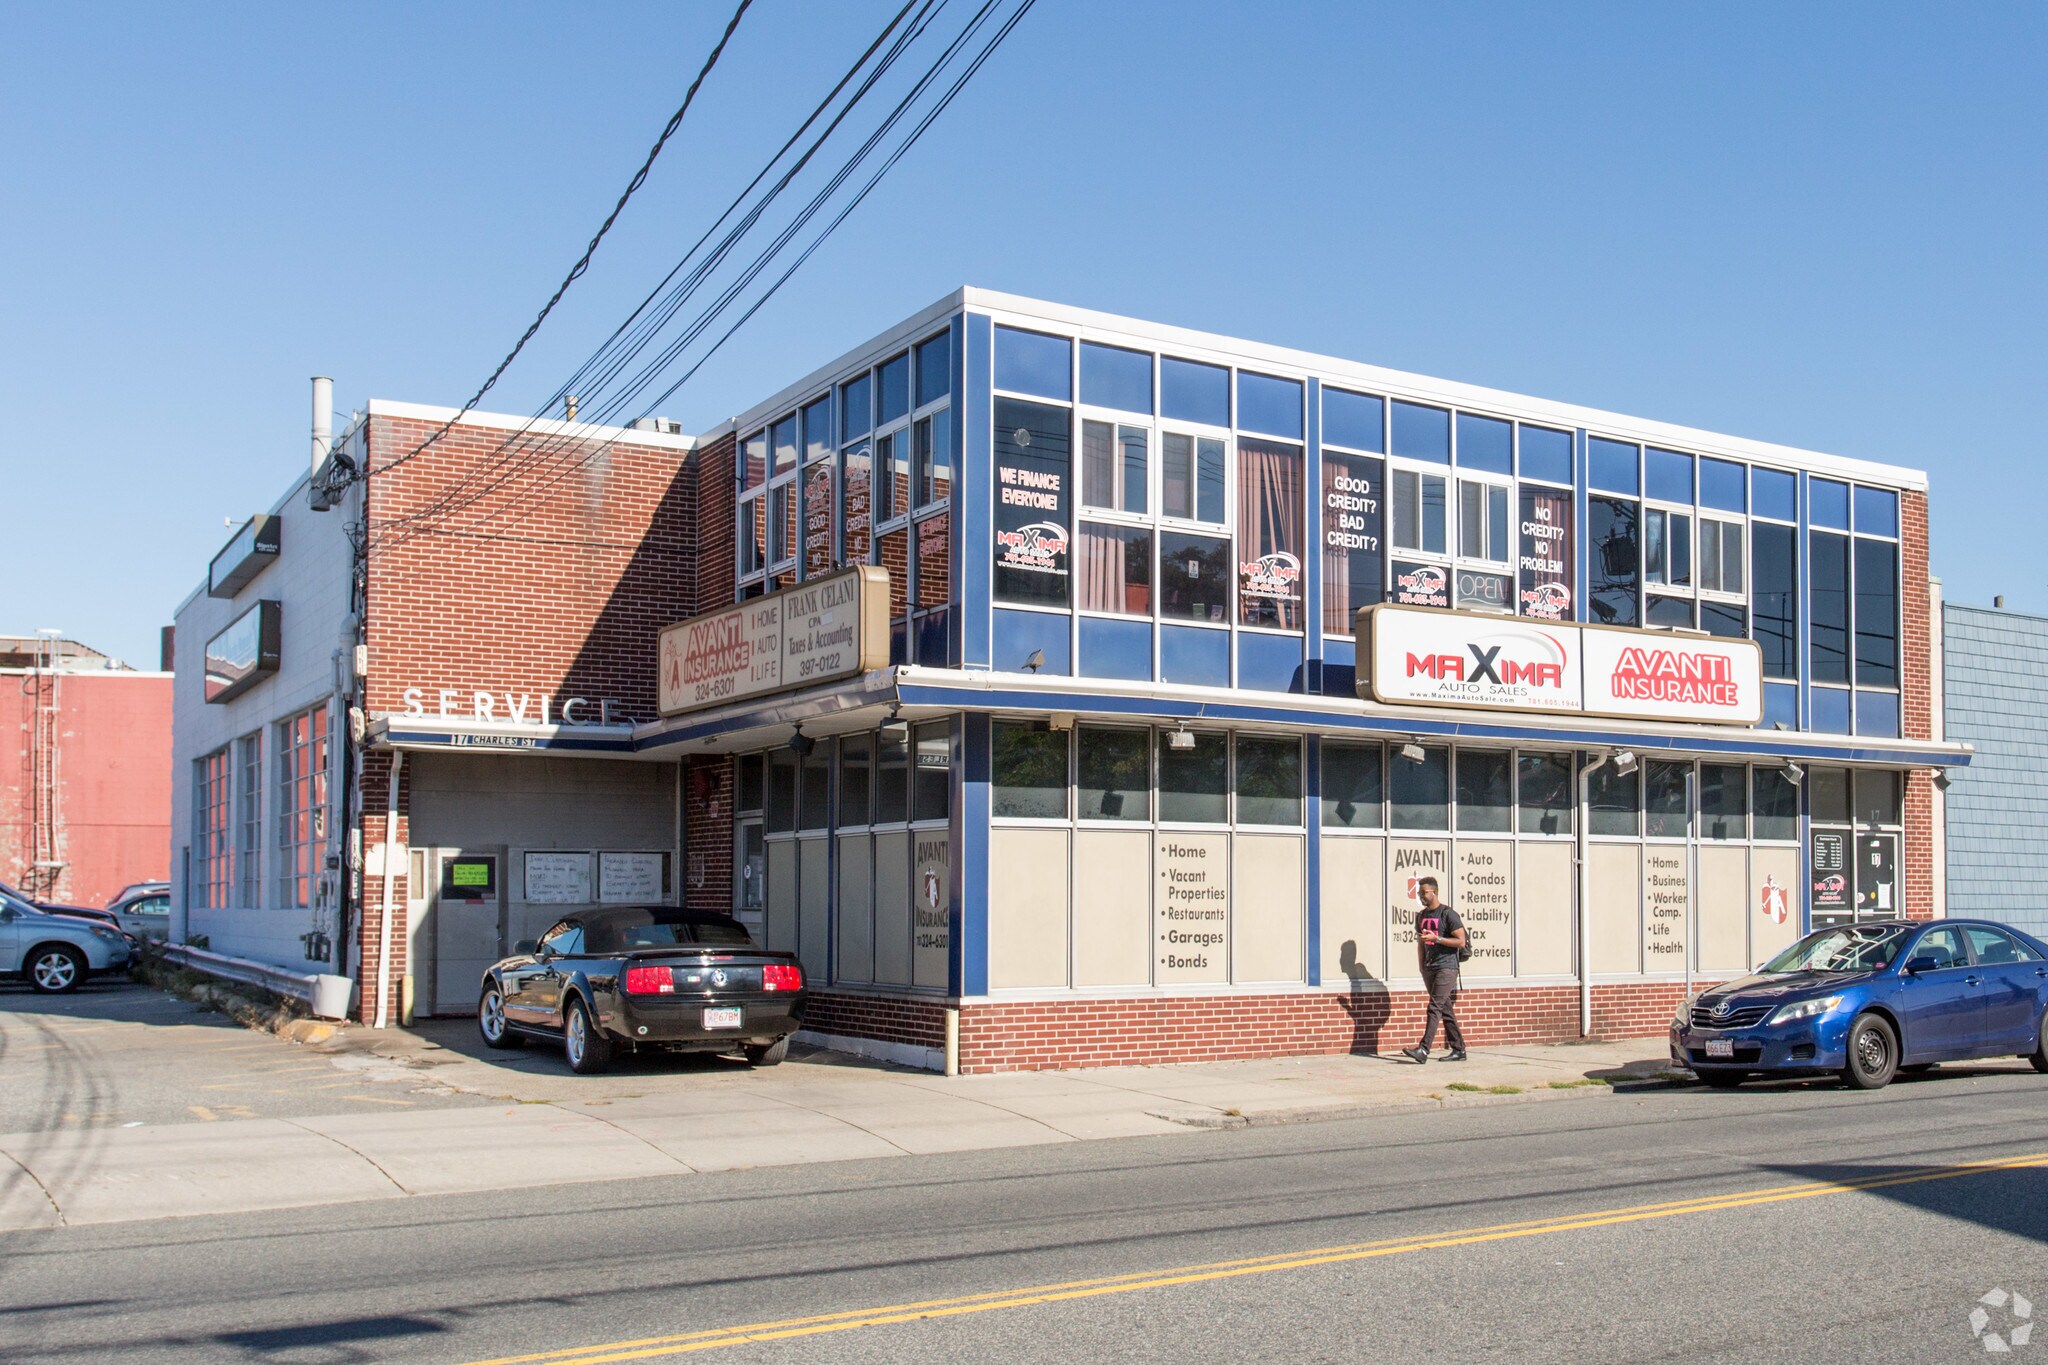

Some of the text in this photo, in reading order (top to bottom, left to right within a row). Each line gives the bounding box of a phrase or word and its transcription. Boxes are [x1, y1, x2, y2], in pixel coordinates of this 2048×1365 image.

[1000, 467, 1059, 491] WE FINANCE
[1334, 476, 1370, 494] GOOD
[852, 495, 864, 511] BAD
[1001, 487, 1057, 510] EVERYONE!
[1327, 493, 1377, 513] CREDIT?
[809, 513, 826, 530] GOOD
[1339, 513, 1364, 530] BAD
[1535, 507, 1551, 520] NO
[1521, 521, 1564, 540] CREDIT?
[806, 530, 829, 550] CREDIT?
[854, 536, 862, 550] NO
[997, 528, 1066, 554] MAXIMA
[1327, 531, 1377, 551] CREDIT?
[1535, 540, 1548, 554] NO
[812, 552, 821, 566] NO
[1520, 556, 1563, 574] PROBLEM!
[1240, 559, 1299, 581] MAXIMA
[1398, 572, 1445, 590] MAXIMA
[1460, 575, 1506, 599] OPEN
[788, 578, 854, 620] FRANK CELANI
[1521, 588, 1569, 610] MAXIMA
[757, 607, 777, 627] HOME
[808, 617, 821, 628] CPA
[687, 612, 743, 658] AVANTI
[789, 624, 853, 656] Taxes & Accounting
[757, 634, 777, 654] AUTO
[684, 641, 749, 684] INSURANCE
[757, 661, 776, 680] LIFE
[800, 653, 840, 676] 397-0122
[1406, 643, 1562, 688] MAXIMA
[1616, 648, 1731, 682] AVANTI
[695, 677, 735, 702] 324-6301
[1409, 692, 1515, 703] www.MaximaAutoSale.com
[1438, 682, 1528, 697] AUTO SALES
[1613, 674, 1738, 706] INSURANCE
[403, 688, 619, 727] SERVICE
[454, 735, 535, 746] 17 CHARLES ST
[1871, 810, 1880, 820] 17
[917, 841, 948, 868] AVANTI
[1168, 844, 1206, 858] Home
[1467, 853, 1493, 865] Auto
[1394, 849, 1445, 872] AVANTI
[1652, 857, 1679, 868] Home
[1169, 868, 1206, 882] Vacant
[1467, 872, 1506, 885] Condos
[1652, 875, 1686, 886] Busines
[1168, 886, 1225, 903] Properties
[1467, 891, 1508, 903] Renters
[1168, 906, 1225, 920] Restaurants
[1467, 908, 1510, 924] Liability
[1653, 906, 1681, 920] Comp.
[1467, 927, 1486, 939] Tax
[1652, 923, 1670, 935] Life
[1168, 930, 1223, 947] Garages
[1471, 945, 1511, 957] ervices
[1653, 941, 1683, 954] Health
[1168, 954, 1208, 968] Bonds
